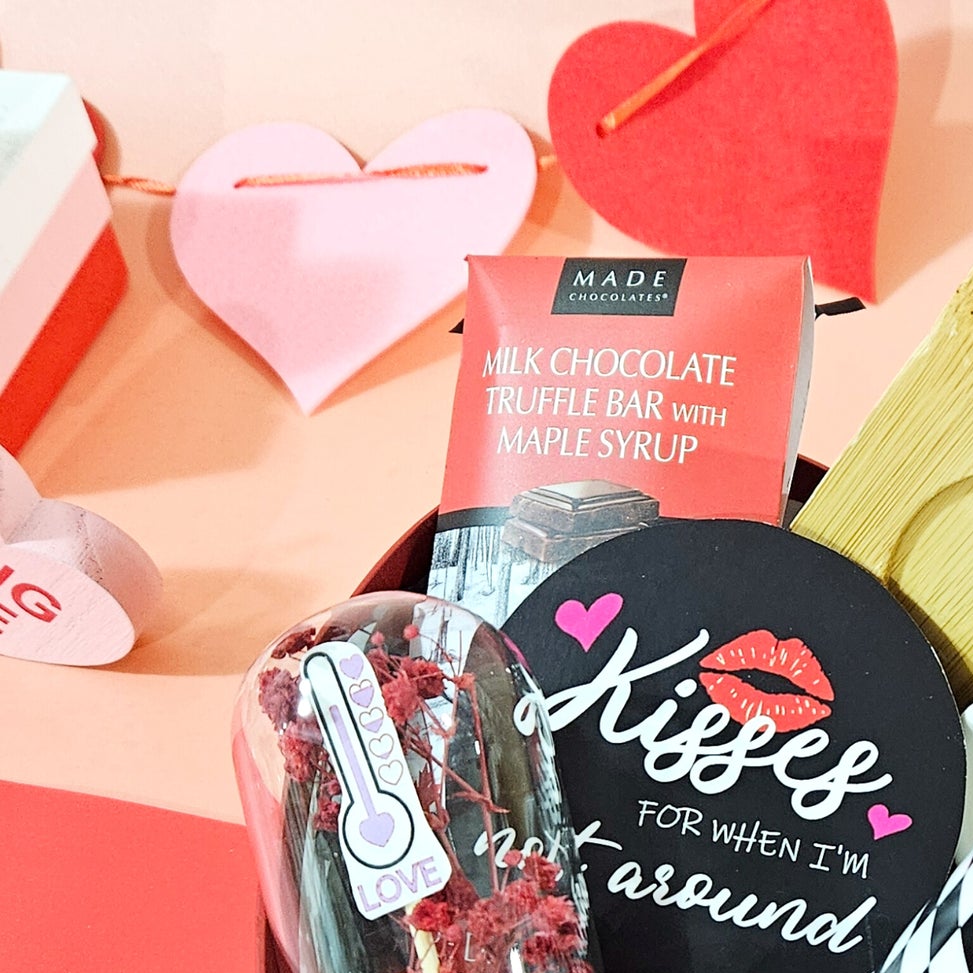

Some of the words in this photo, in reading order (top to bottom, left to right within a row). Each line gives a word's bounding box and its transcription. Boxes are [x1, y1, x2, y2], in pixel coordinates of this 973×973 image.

[572, 270, 667, 287] MADE
[482, 346, 541, 378] MILK
[550, 347, 737, 387] CHOCOLATE
[486, 386, 599, 417] TRUFFLE
[605, 389, 664, 420] BAR
[672, 402, 727, 427] WITH
[496, 426, 591, 457] MAPLE
[599, 429, 698, 464] SYRUP
[513, 627, 893, 820] Kisses
[637, 800, 703, 836] FOR
[712, 820, 800, 859] WHEN
[808, 841, 871, 879] I'M
[356, 855, 442, 913] LOVE
[607, 860, 877, 953] around
